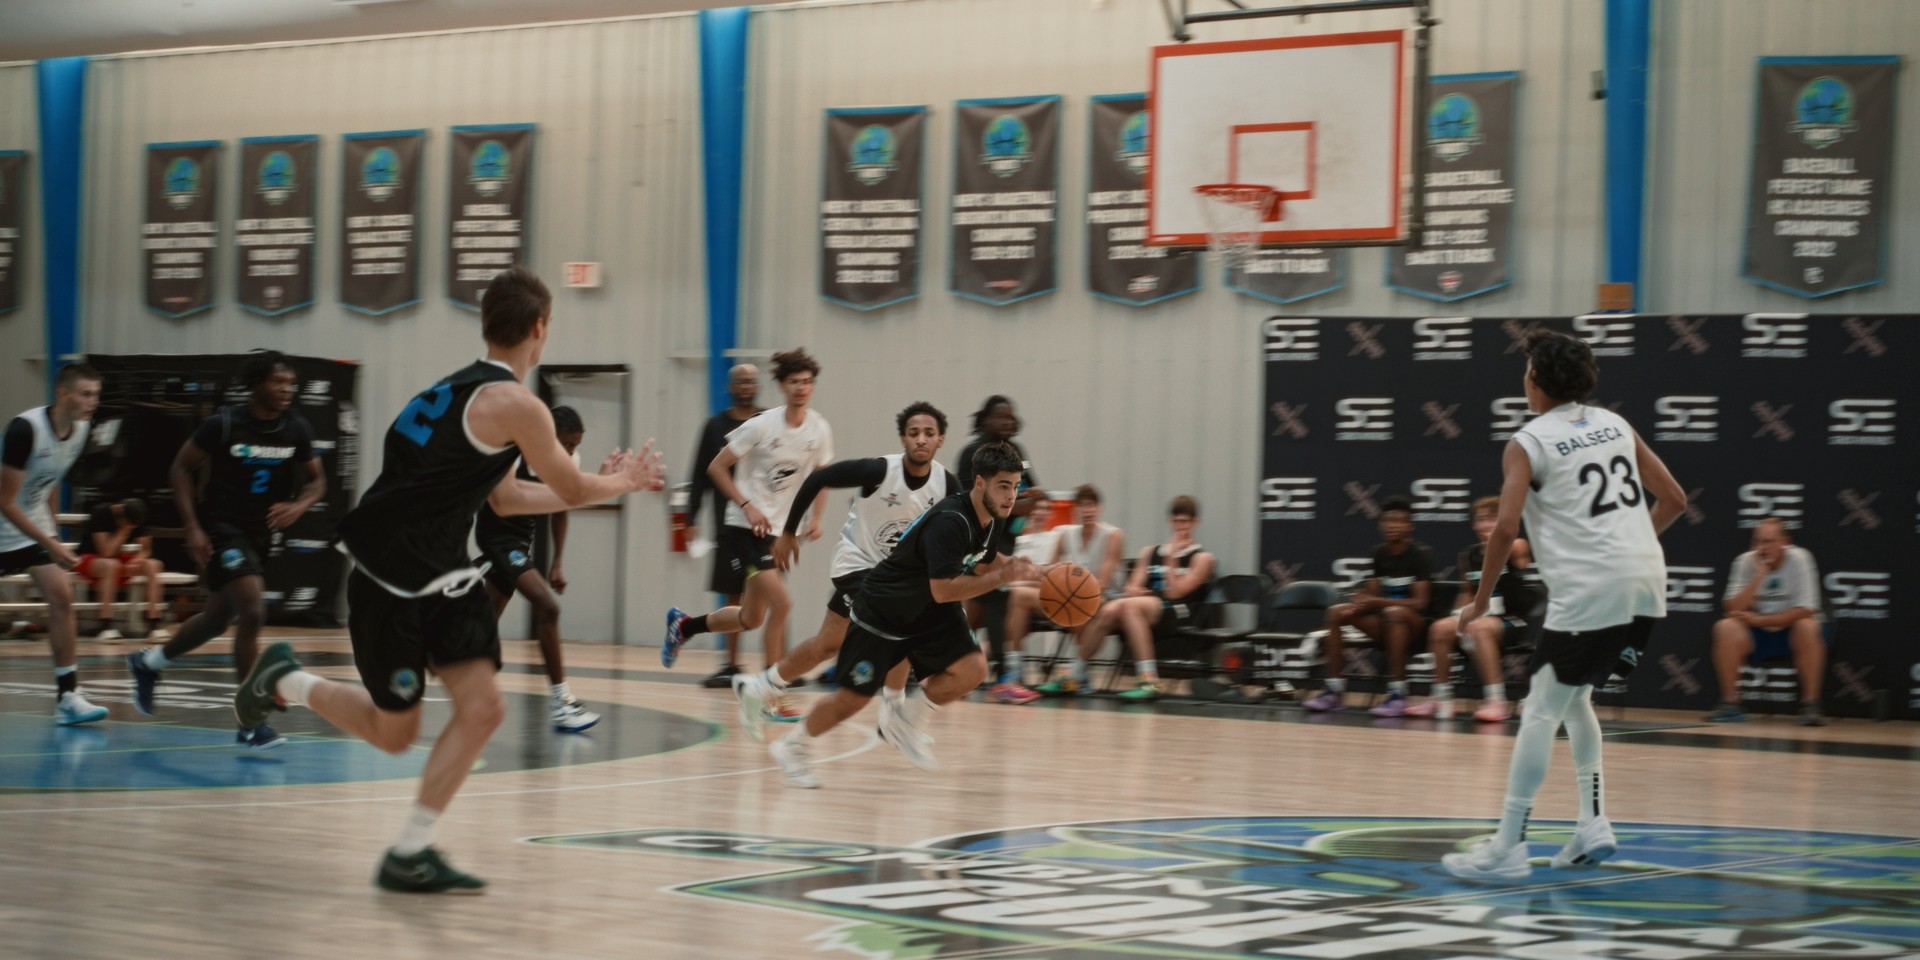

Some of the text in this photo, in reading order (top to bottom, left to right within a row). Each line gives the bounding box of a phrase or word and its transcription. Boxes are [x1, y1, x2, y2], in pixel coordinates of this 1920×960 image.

[394, 383, 453, 447] 2
[1555, 427, 1624, 456] BALSECA
[250, 469, 271, 494] 2
[1578, 454, 1640, 518] 23
[927, 497, 935, 507] 4
